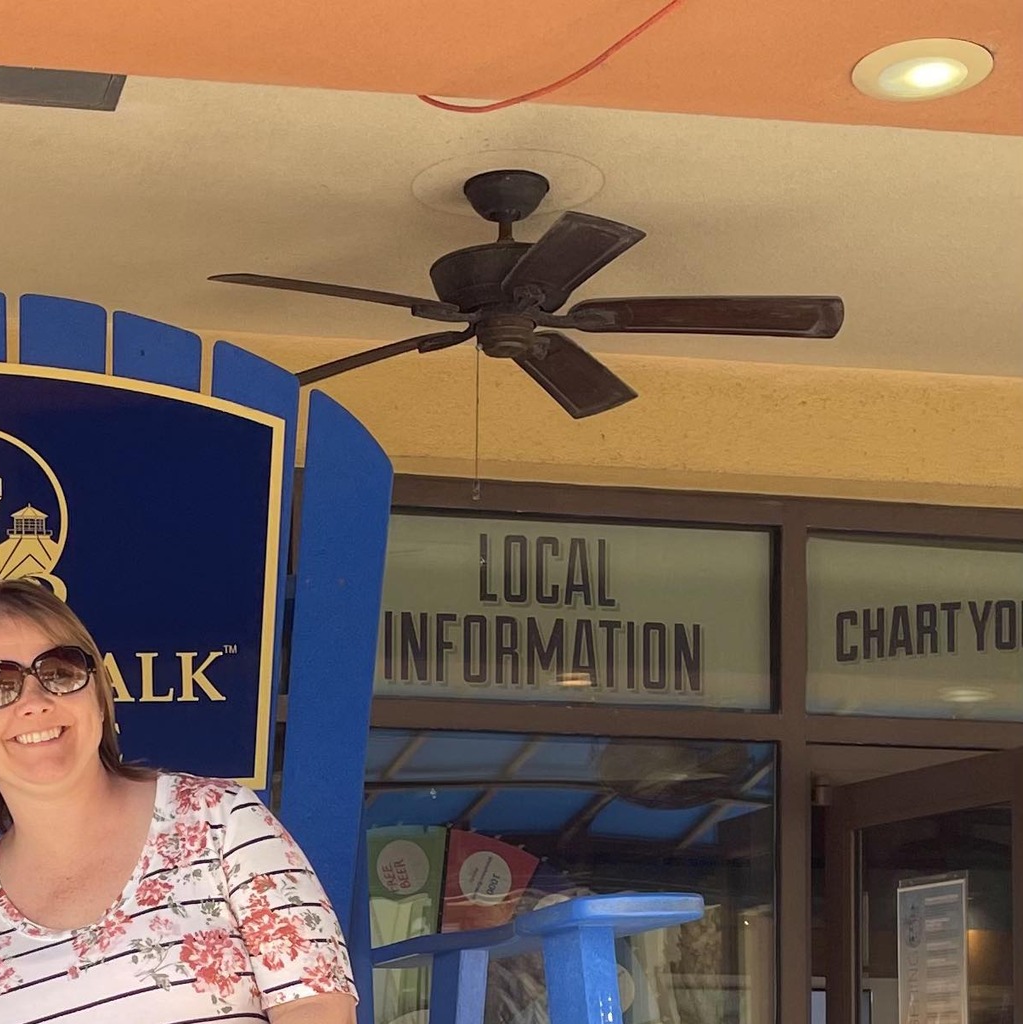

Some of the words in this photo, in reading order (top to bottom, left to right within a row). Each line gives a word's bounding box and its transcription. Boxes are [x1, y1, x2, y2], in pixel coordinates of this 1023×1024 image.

[479, 532, 616, 608] LOCAL
[383, 611, 702, 692] INFORMATION
[836, 601, 962, 663] CHART
[967, 599, 1023, 652] YO
[394, 859, 411, 889] BEER
